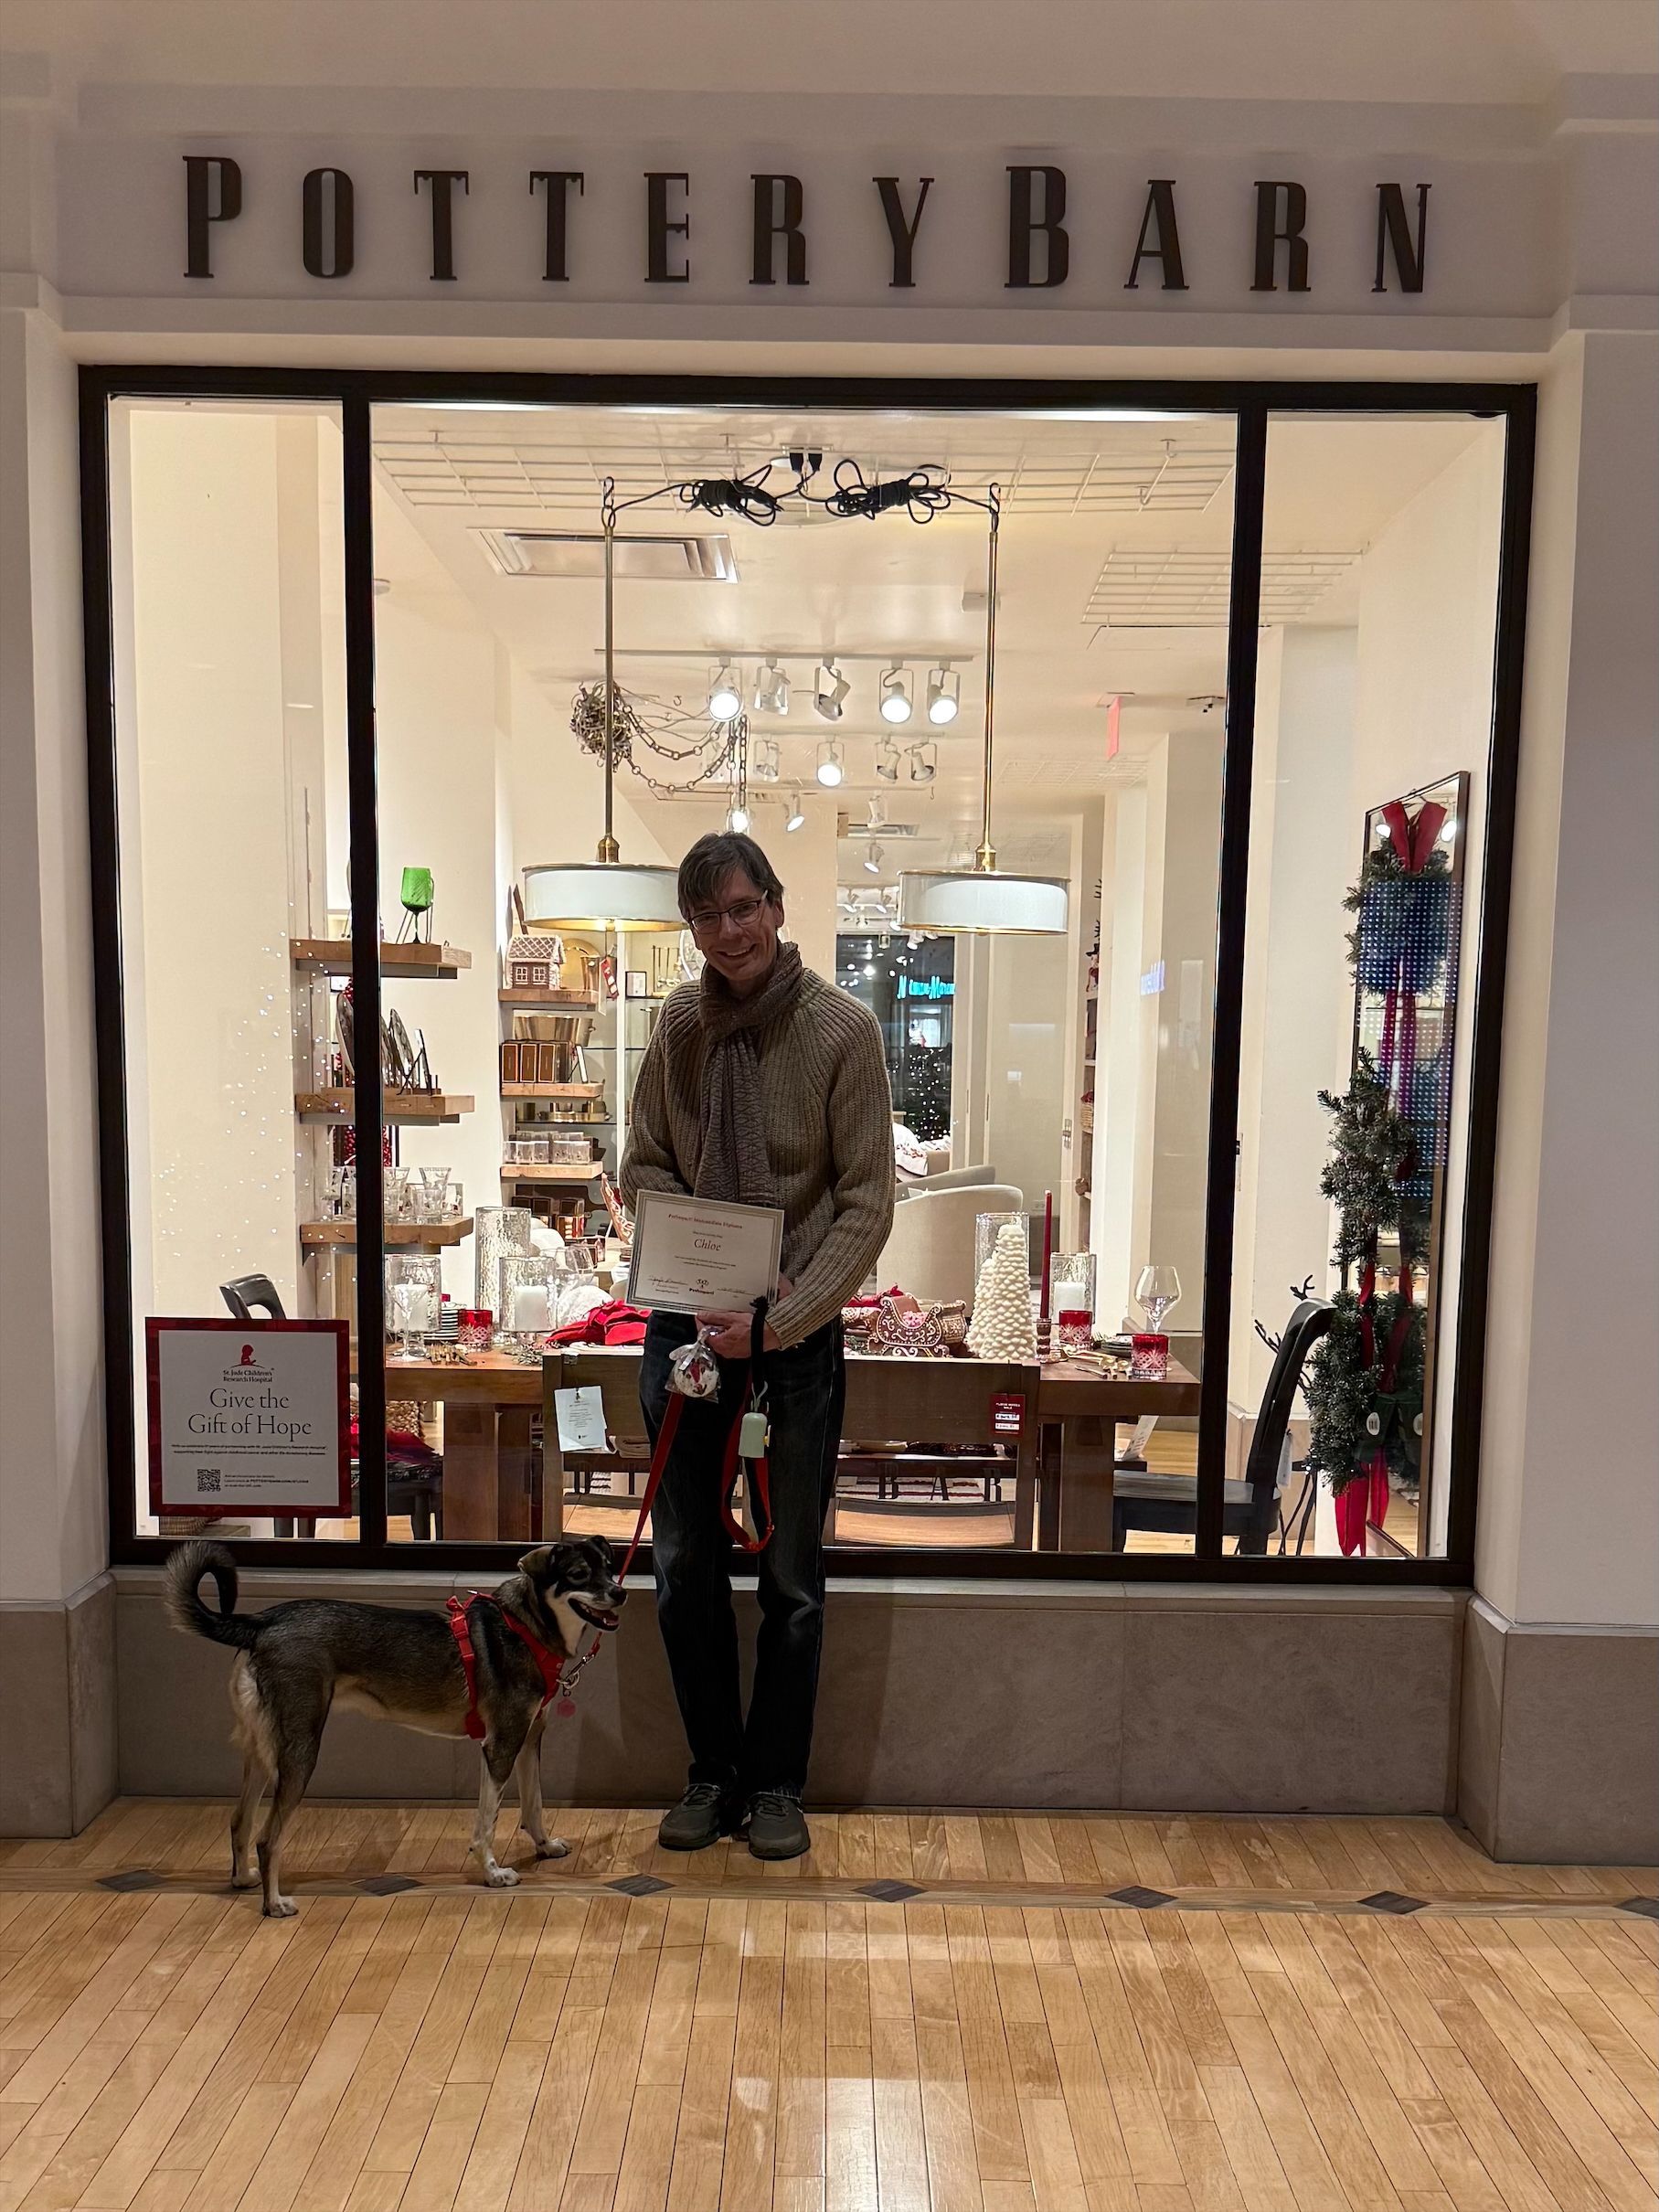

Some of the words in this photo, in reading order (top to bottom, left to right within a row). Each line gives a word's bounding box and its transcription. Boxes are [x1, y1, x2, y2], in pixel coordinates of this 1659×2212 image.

[183, 155, 935, 288] POTTERY
[1005, 165, 1432, 293] BARN
[694, 1239, 721, 1252] Chloe
[209, 1388, 254, 1409] Give
[260, 1388, 290, 1409] the
[188, 1413, 229, 1435] Gift
[231, 1413, 252, 1435] of
[257, 1415, 312, 1442] Hope
